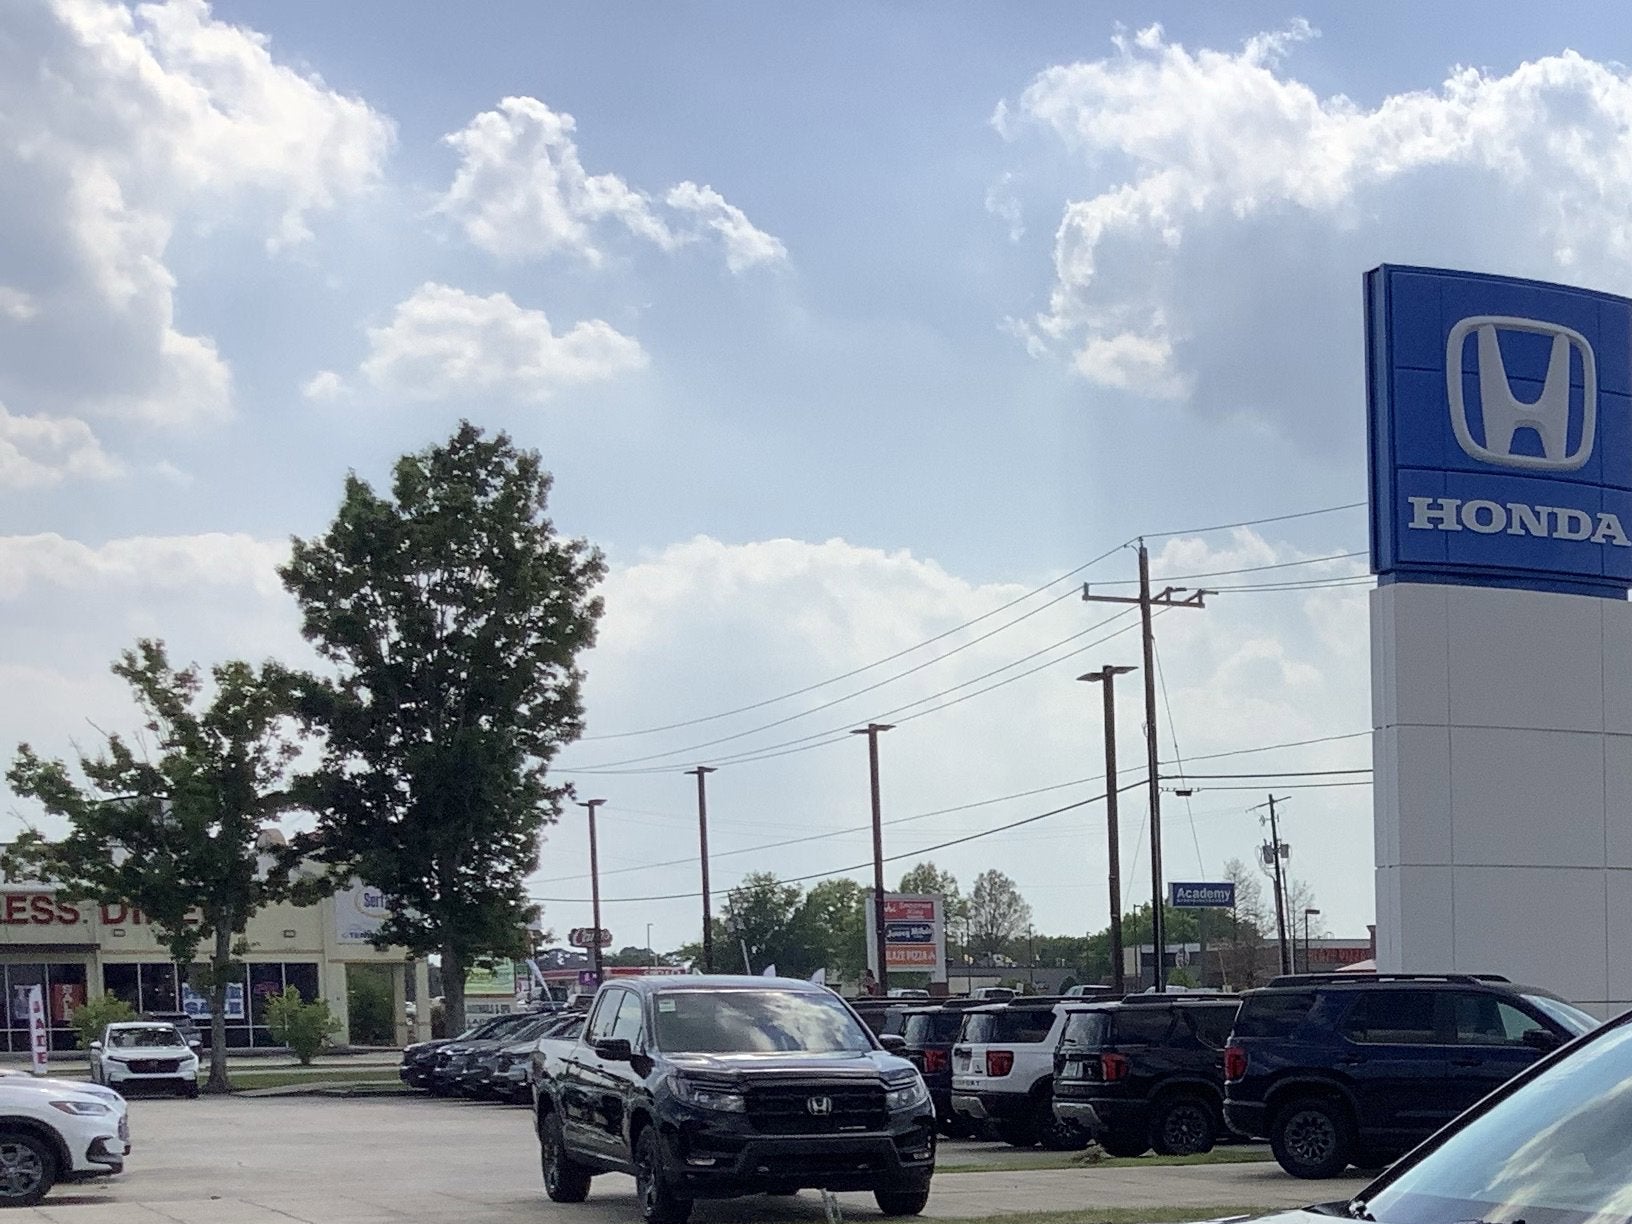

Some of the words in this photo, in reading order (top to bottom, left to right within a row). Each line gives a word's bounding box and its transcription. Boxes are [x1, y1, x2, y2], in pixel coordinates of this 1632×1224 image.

[1408, 497, 1632, 547] HONDA
[1176, 887, 1232, 902] Academy
[0, 895, 80, 925] ESS
